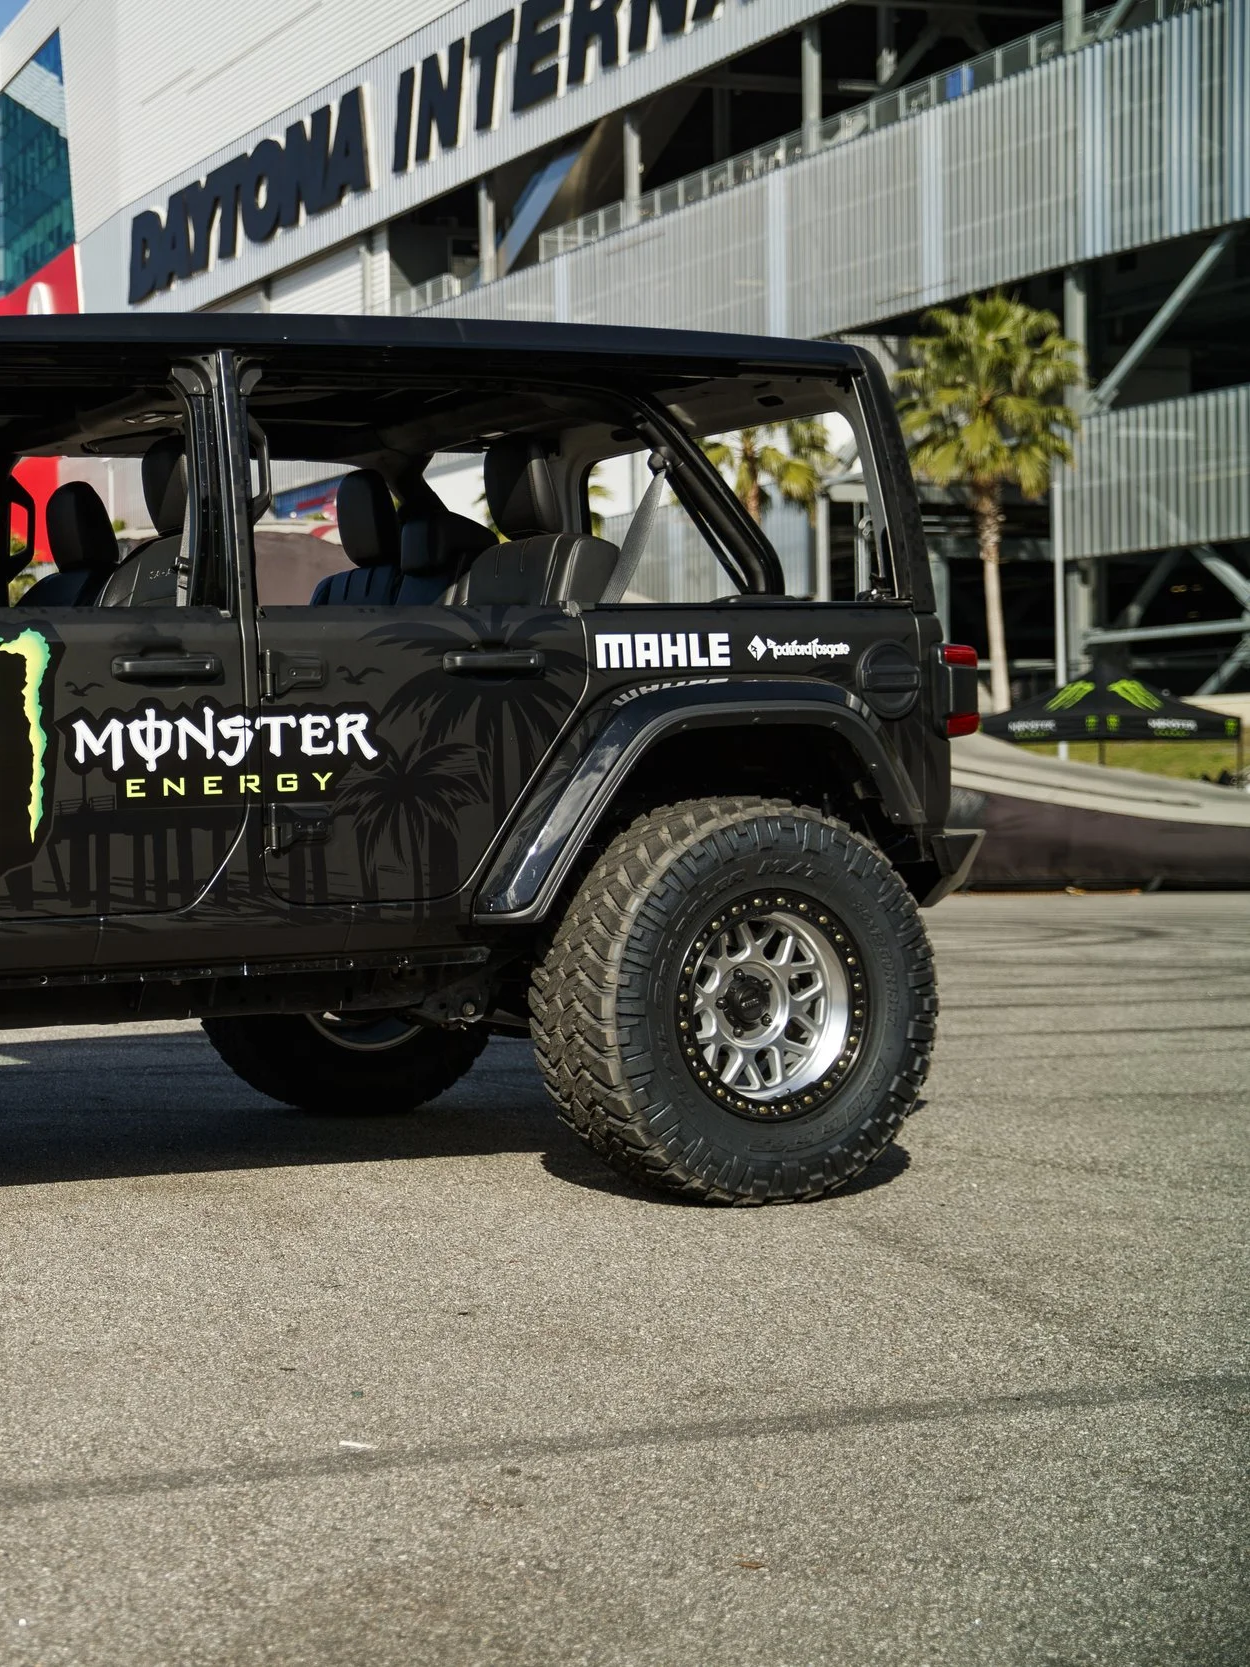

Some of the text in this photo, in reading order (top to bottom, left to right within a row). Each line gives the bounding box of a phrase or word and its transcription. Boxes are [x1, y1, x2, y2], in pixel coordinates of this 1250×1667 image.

[128, 0, 740, 306] DAYTONA INTER
[595, 632, 731, 669] MAHLE
[125, 771, 334, 799] ENERGY
